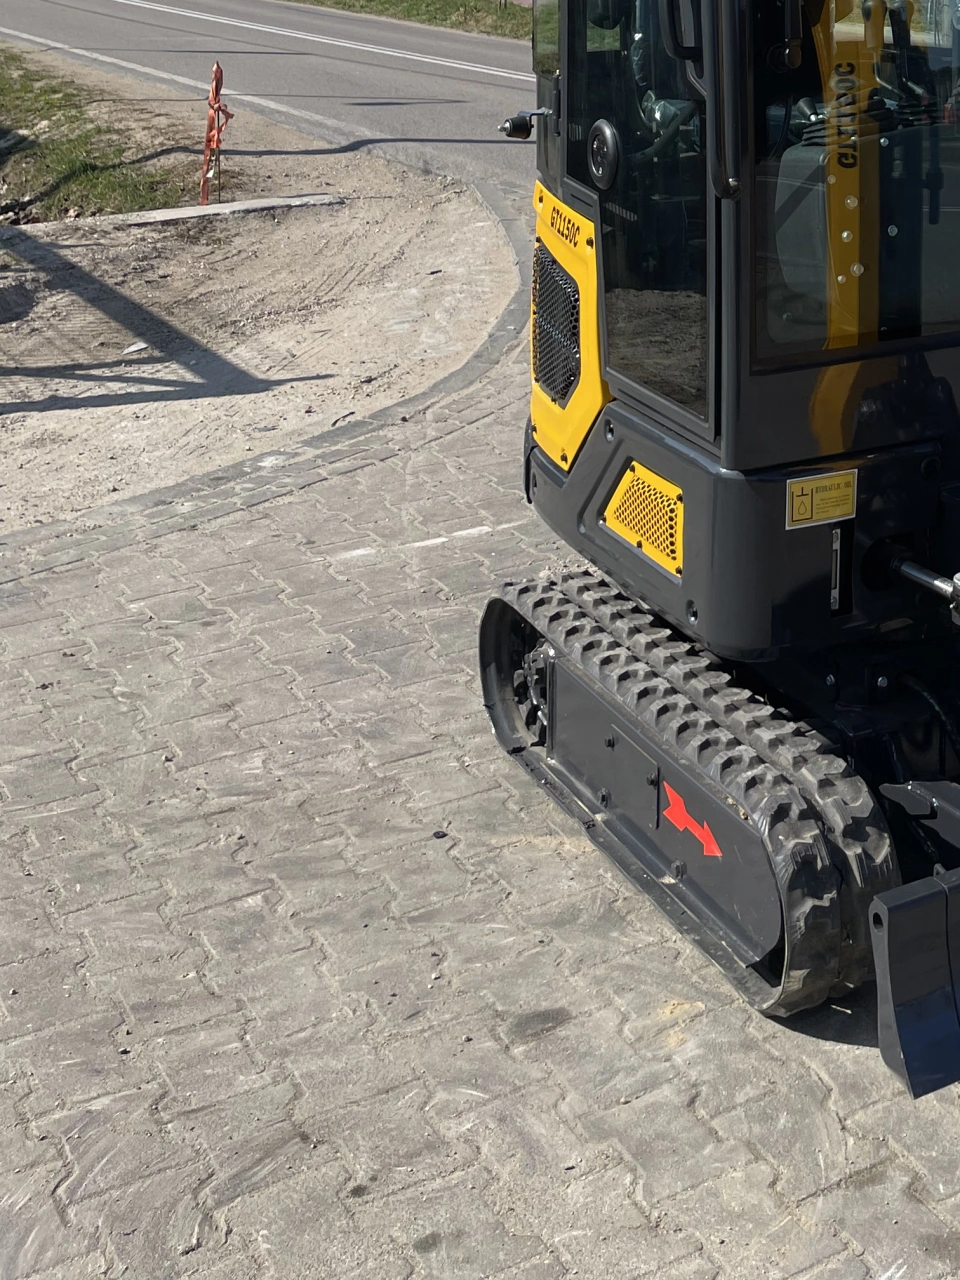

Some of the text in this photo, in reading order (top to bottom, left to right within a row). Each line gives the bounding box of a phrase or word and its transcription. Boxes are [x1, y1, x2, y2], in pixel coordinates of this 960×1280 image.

[550, 205, 581, 248] GT1150C
[815, 480, 852, 494] HYDRAULIC OIL
